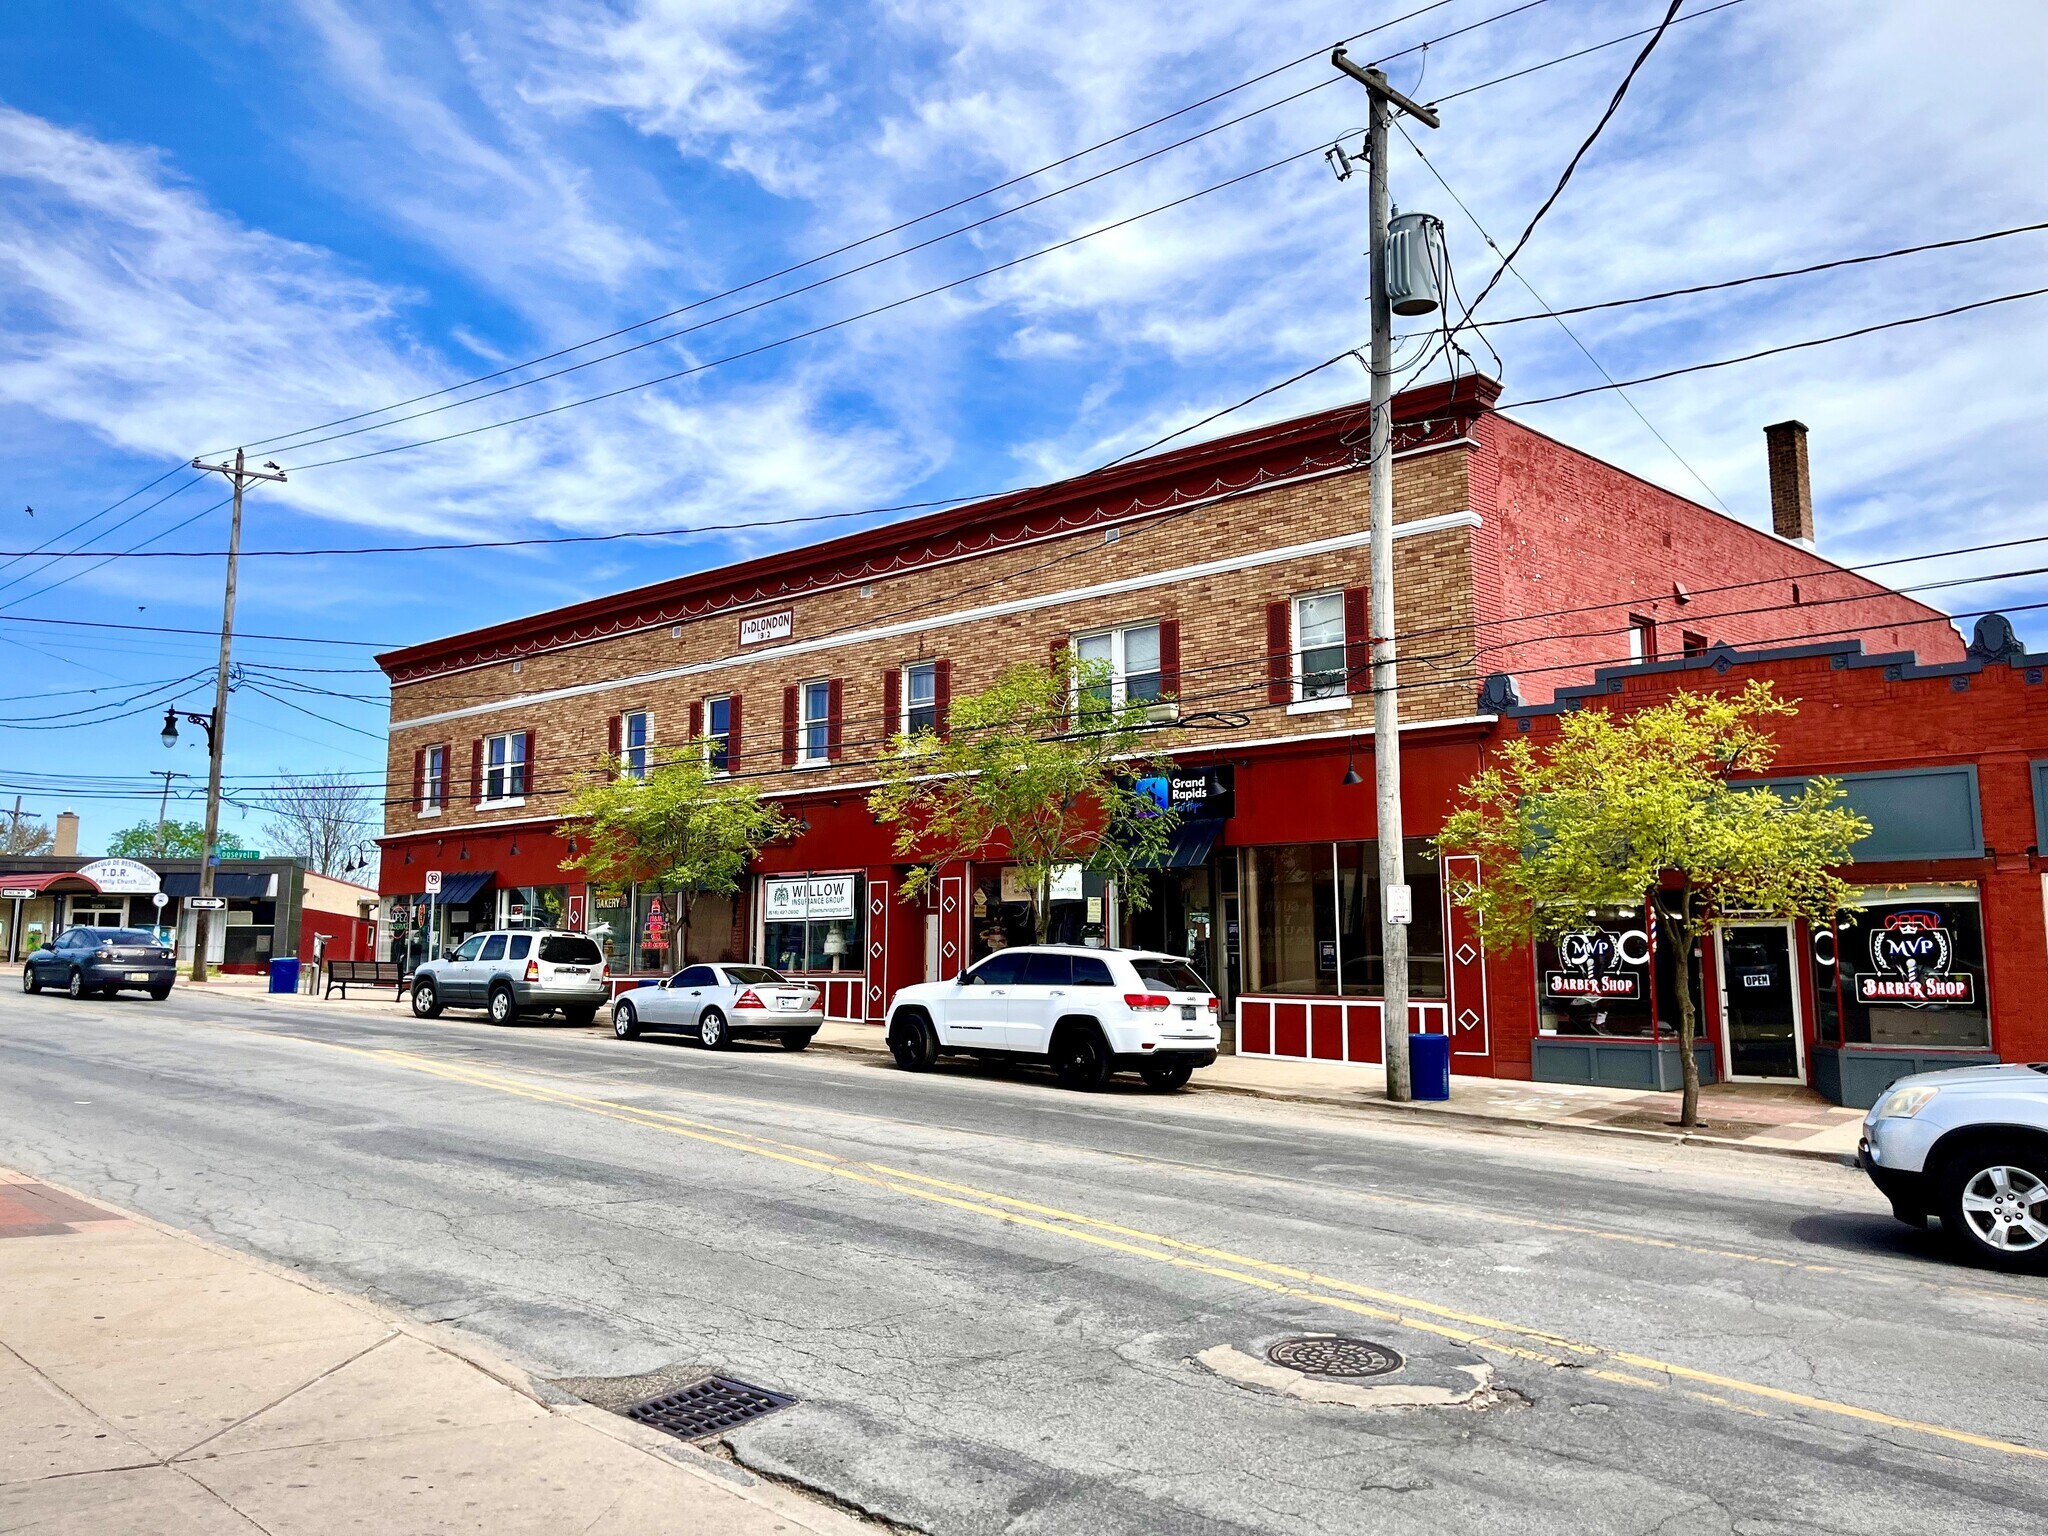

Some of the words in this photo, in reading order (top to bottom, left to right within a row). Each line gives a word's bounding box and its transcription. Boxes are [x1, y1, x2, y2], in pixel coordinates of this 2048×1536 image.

[1172, 776, 1206, 789] Grand
[1172, 788, 1207, 801] Rapids
[216, 850, 253, 859] oosevelt
[792, 883, 845, 898] WILLOW
[595, 898, 620, 909] BAKERY
[825, 896, 845, 904] GROUP
[1884, 914, 1938, 930] OPEN
[1571, 938, 1609, 957] MVP
[1886, 936, 1934, 957] MVP
[1551, 976, 1601, 993] BARBER
[1601, 976, 1633, 992] SHOP
[1745, 975, 1768, 986] OPEN
[1862, 978, 1927, 998] BARBER
[1926, 977, 1965, 996] SHOP
